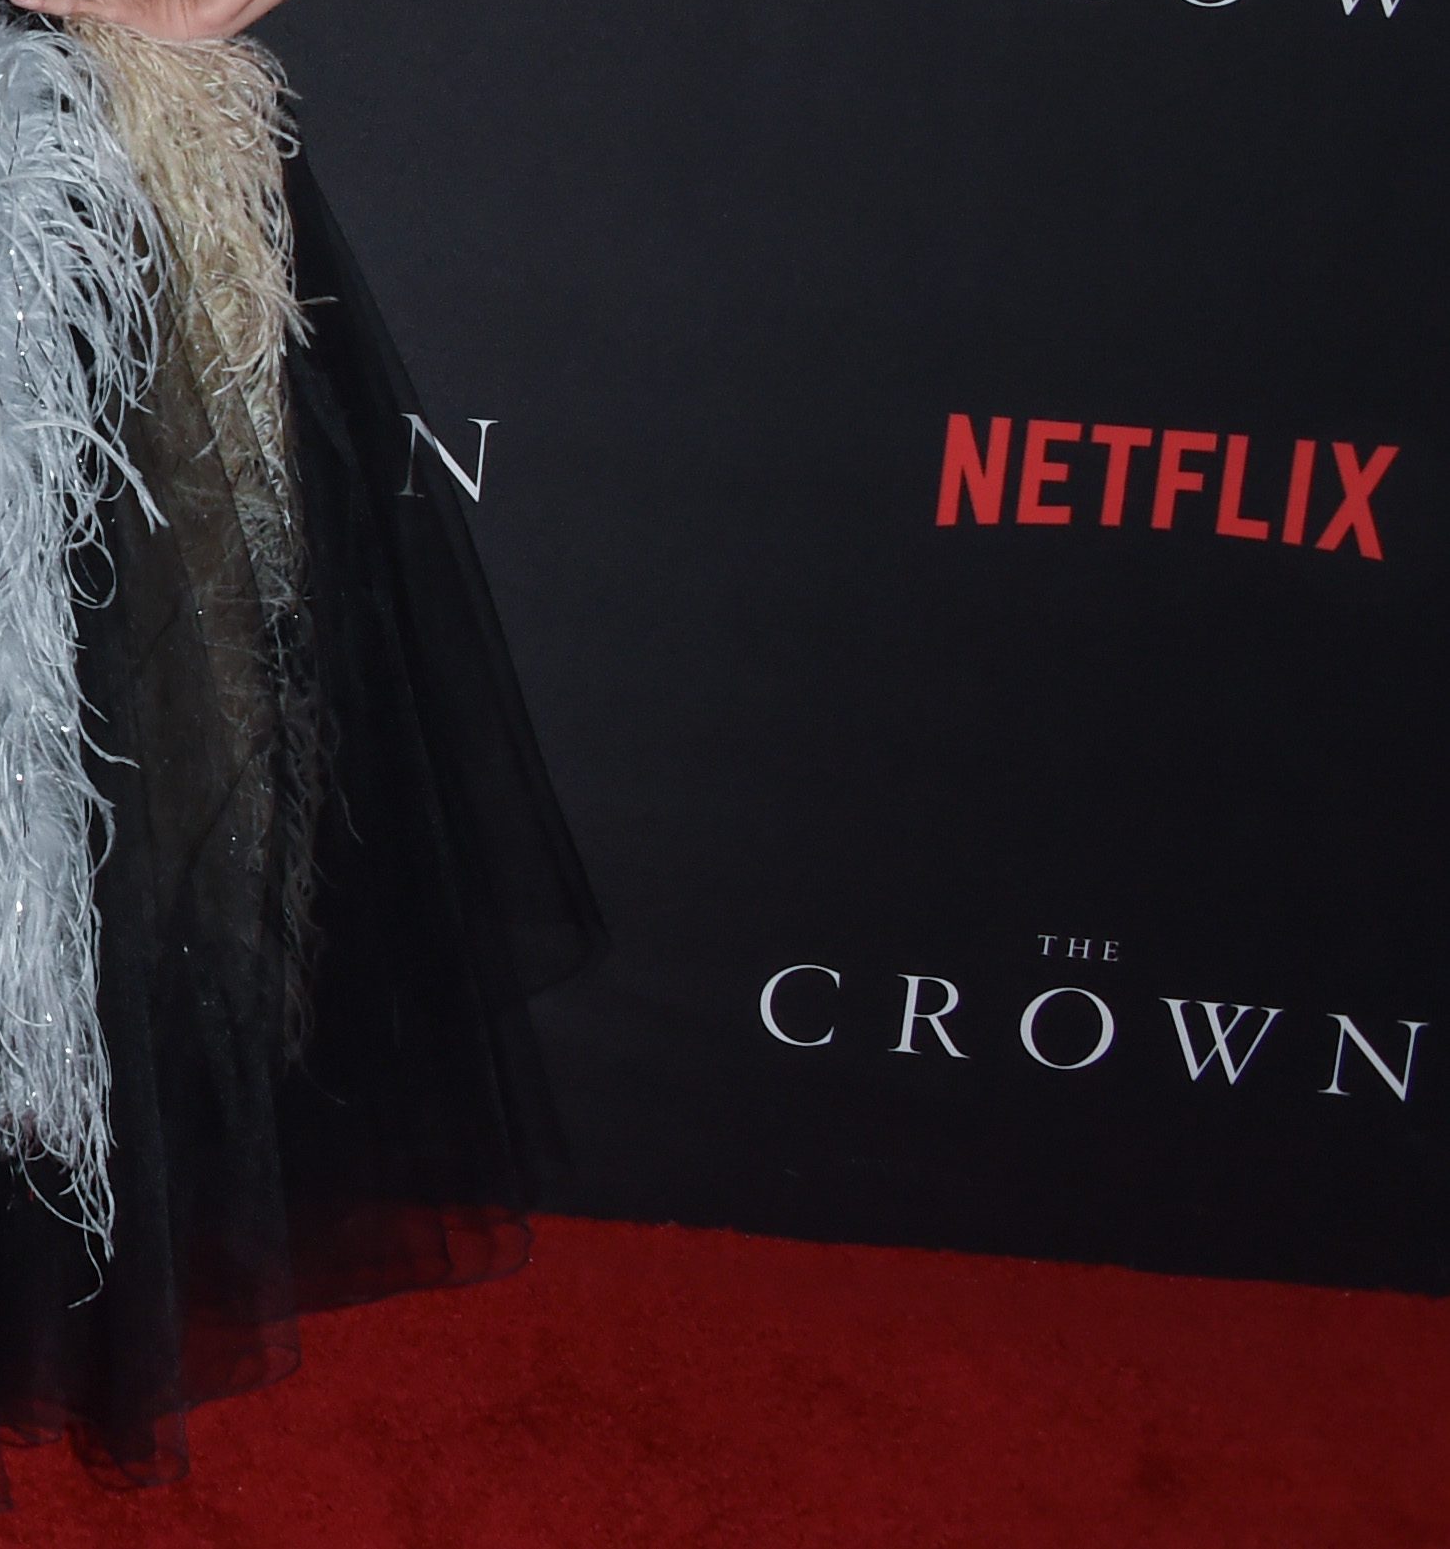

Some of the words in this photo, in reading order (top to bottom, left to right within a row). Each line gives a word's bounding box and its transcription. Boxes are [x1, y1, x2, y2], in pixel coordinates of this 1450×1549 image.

[935, 412, 1400, 561] NETFLIX
[1037, 934, 1120, 962] THE
[759, 964, 1429, 1102] CROWN
